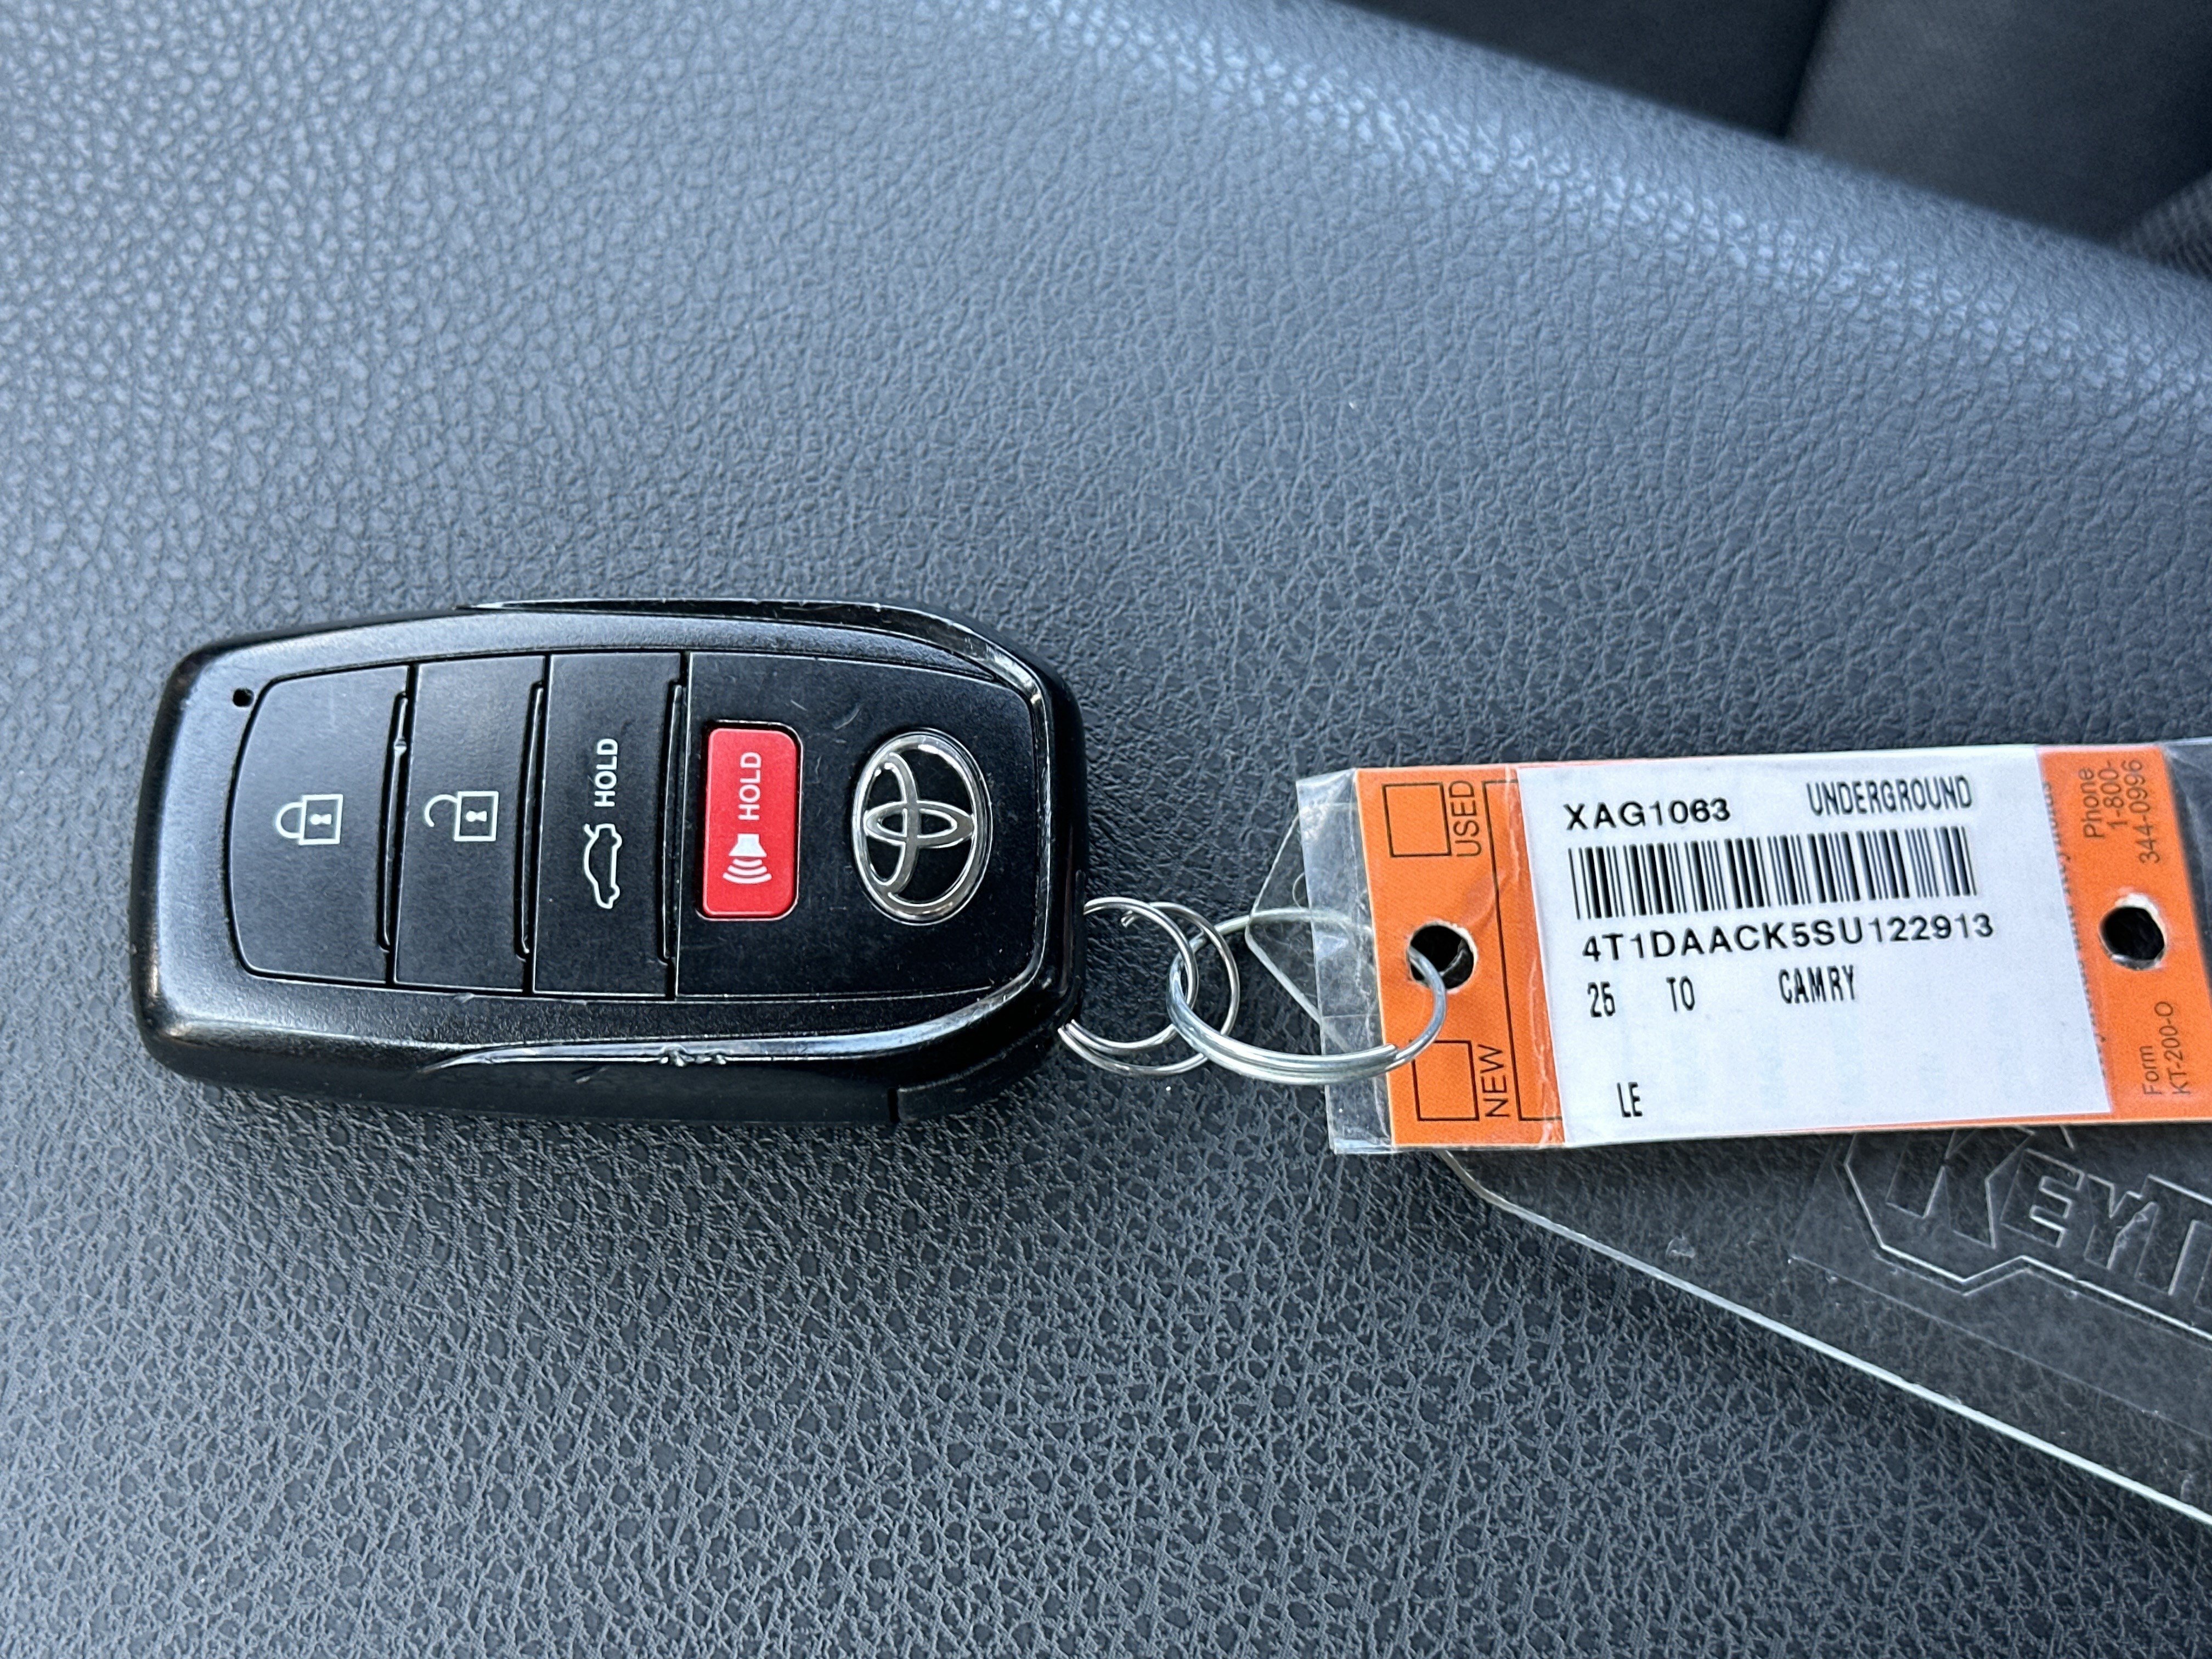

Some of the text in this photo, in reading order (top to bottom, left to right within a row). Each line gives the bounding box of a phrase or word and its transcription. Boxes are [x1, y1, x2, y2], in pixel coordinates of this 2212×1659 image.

[594, 738, 619, 808] HOLD
[737, 751, 763, 821] HOLD
[1806, 775, 1974, 817] UNDERGROUND
[2078, 768, 2106, 839] Phone
[2097, 759, 2129, 829] 1-800-
[1448, 780, 1482, 857] USED
[1563, 798, 1732, 831] XAG1063
[2120, 759, 2160, 864] 344-0996
[1582, 912, 1994, 962] 4T1DAACK5SU122913
[1587, 964, 1856, 1018] 25 TO CAMRY
[1479, 1044, 1510, 1118] NEW
[1616, 1081, 1644, 1119] LE
[2140, 1045, 2163, 1095] Form
[1885, 1127, 2212, 1311] KEYT
